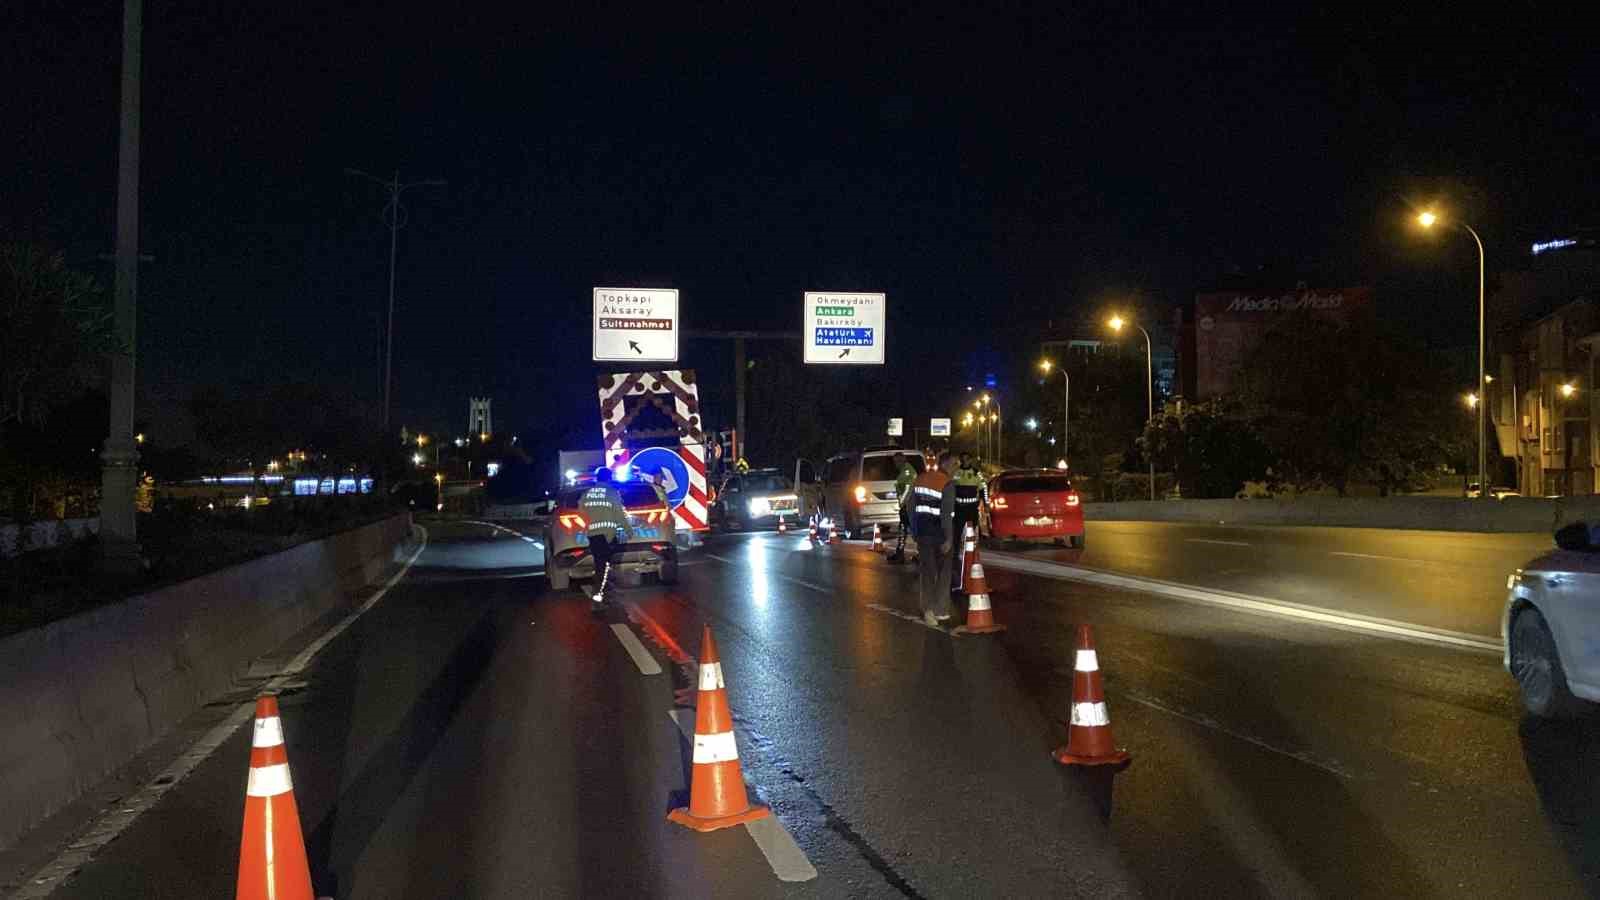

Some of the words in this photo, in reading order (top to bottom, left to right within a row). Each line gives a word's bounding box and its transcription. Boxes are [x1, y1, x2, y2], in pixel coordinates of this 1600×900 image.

[601, 294, 651, 304] Topkapı
[601, 304, 653, 316] Aksaray
[816, 307, 853, 315] Ankara
[601, 319, 670, 328] Sultanahmet
[816, 318, 863, 326] Bakırköy
[816, 328, 856, 337] Atatürk
[816, 336, 873, 345] Havalimanı
